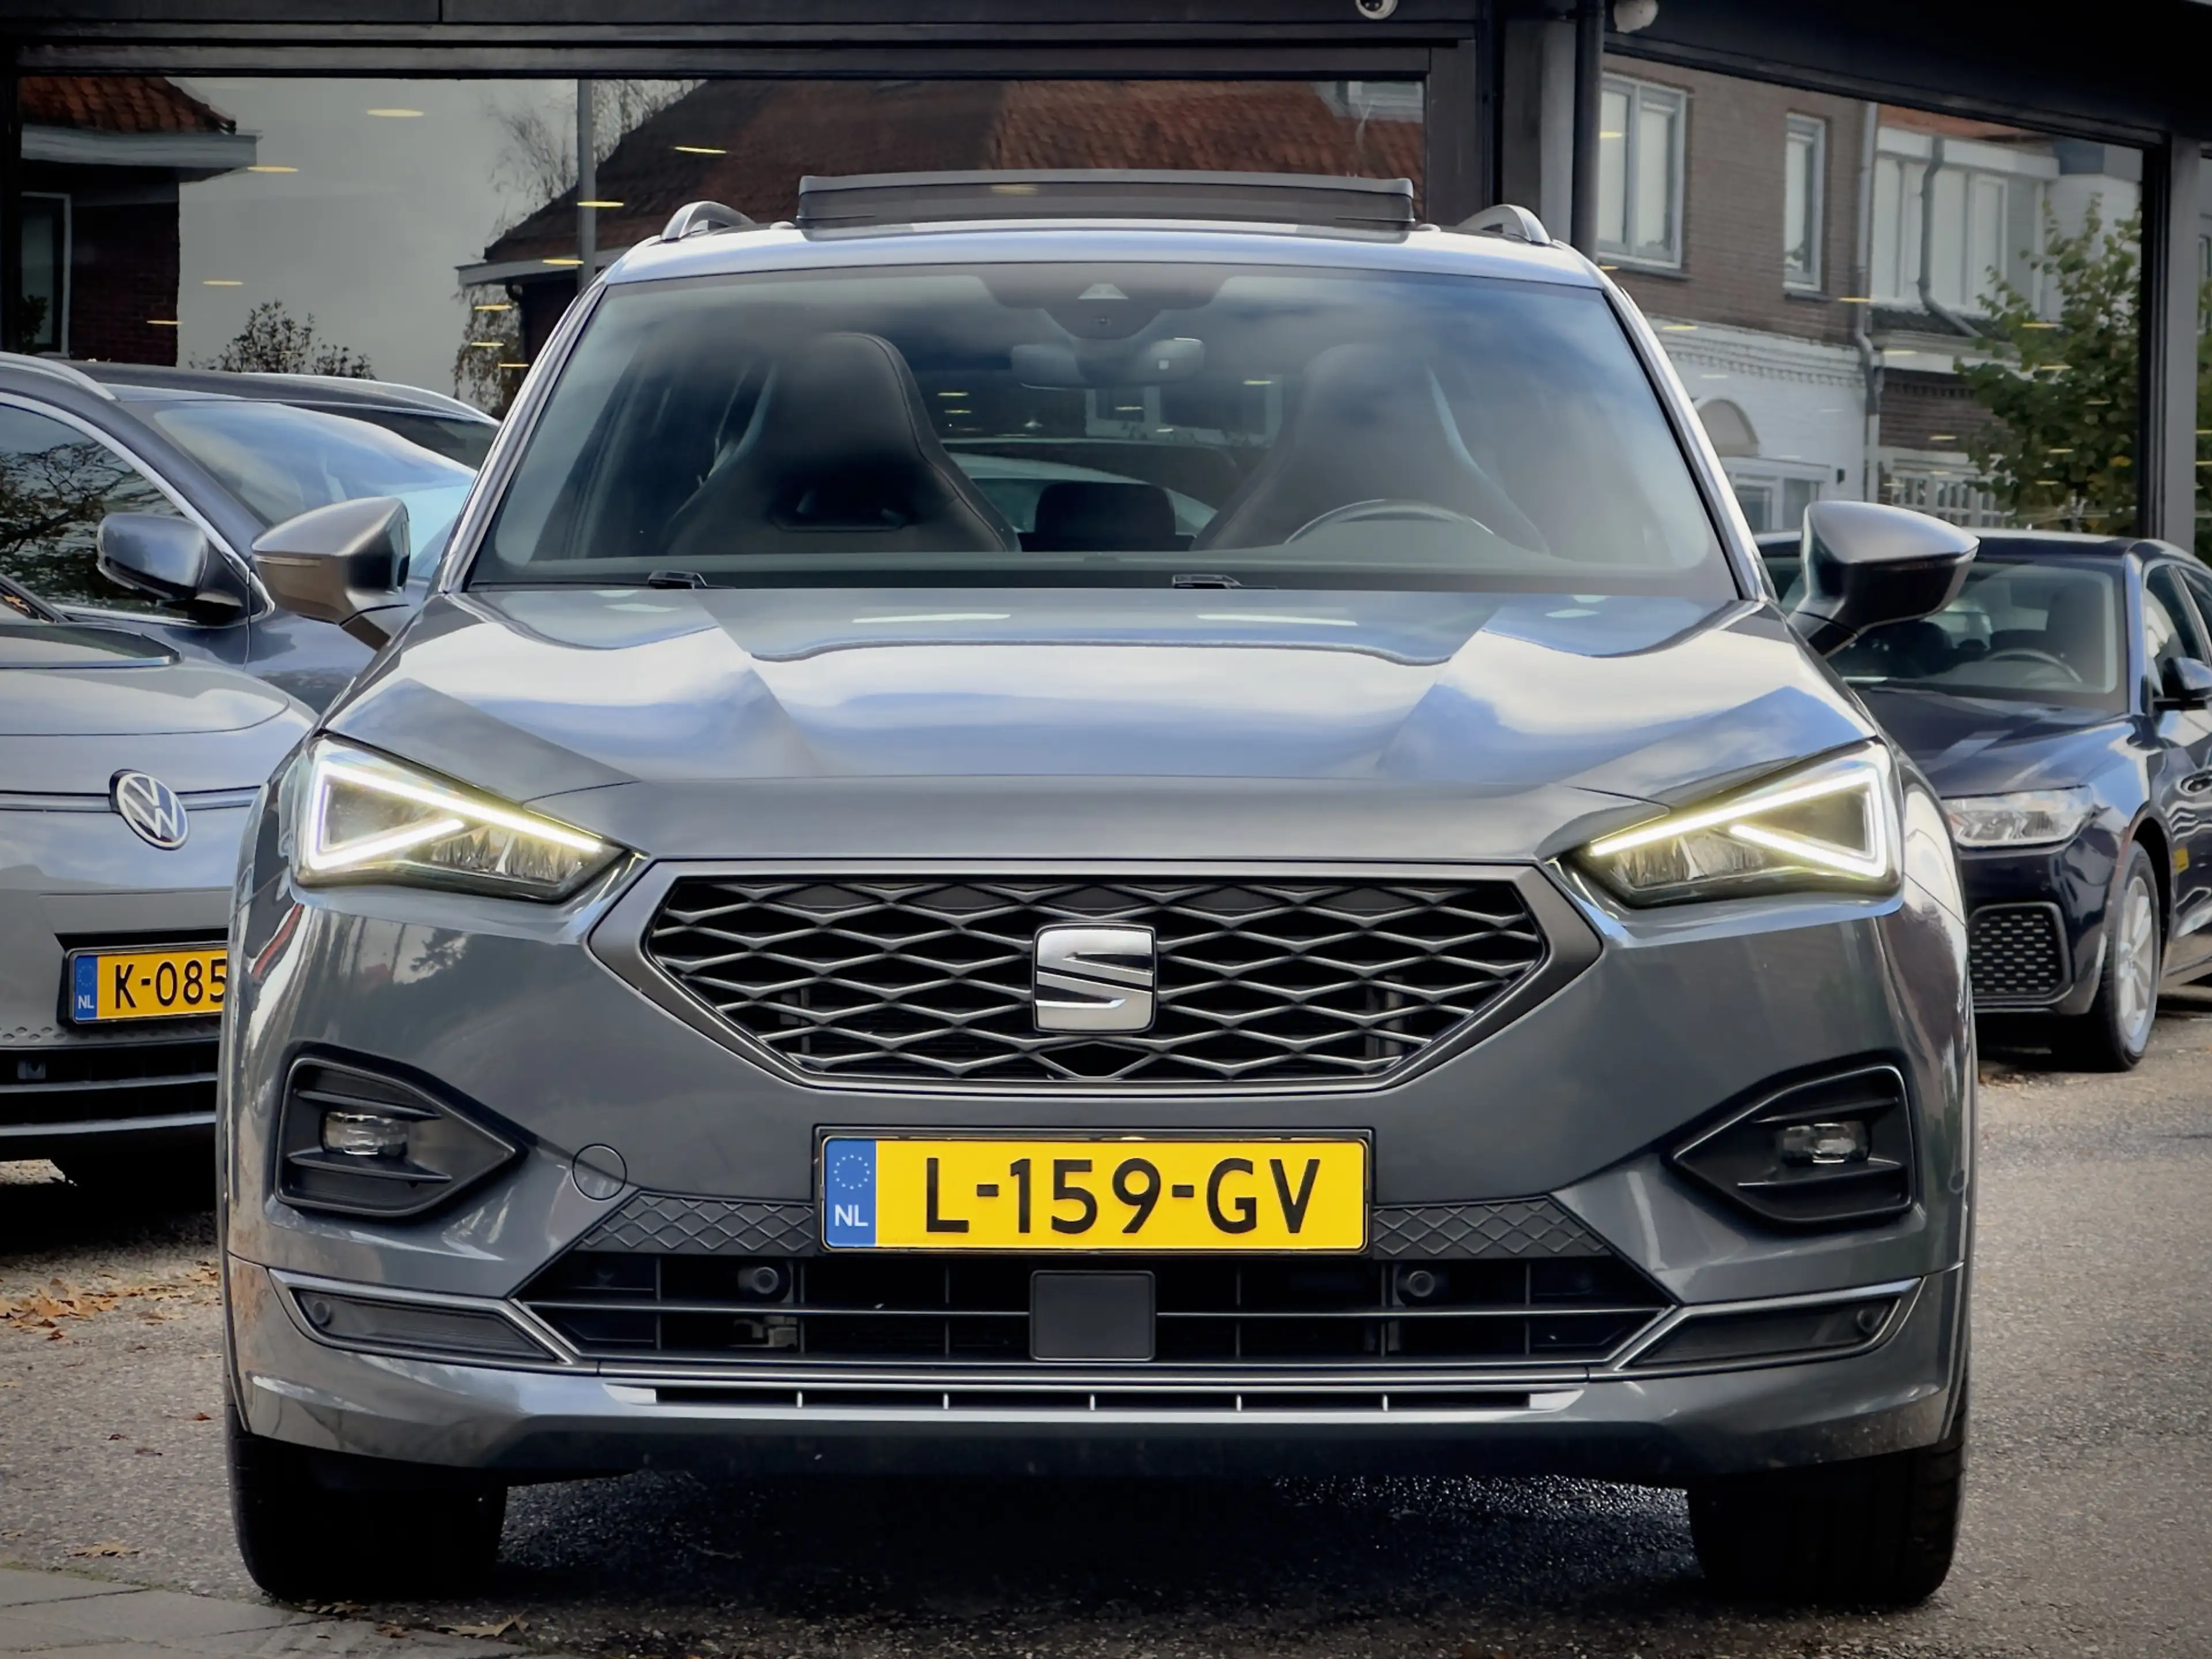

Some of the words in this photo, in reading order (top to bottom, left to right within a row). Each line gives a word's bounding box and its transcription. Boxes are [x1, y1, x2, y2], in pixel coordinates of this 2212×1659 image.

[115, 958, 228, 1009] K-085
[78, 995, 94, 1009] NL
[926, 1157, 1320, 1234] L-159-GV
[835, 1205, 869, 1227] NL
